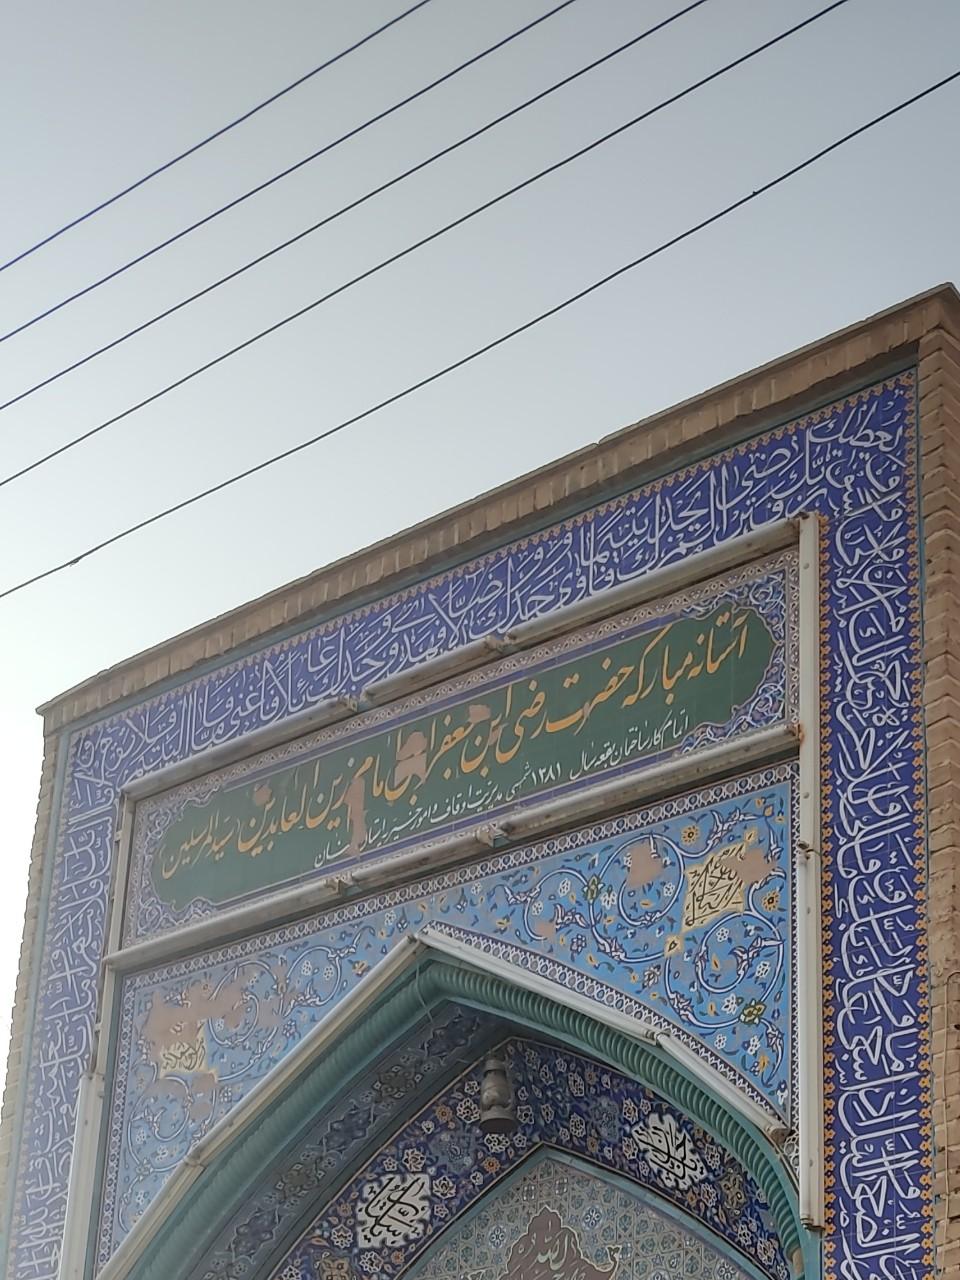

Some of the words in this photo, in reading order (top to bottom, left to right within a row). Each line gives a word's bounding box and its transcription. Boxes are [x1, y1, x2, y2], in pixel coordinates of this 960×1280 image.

[620, 623, 694, 709] مبارکه
[686, 611, 749, 680] آستانه
[496, 680, 547, 764] رضی
[545, 657, 635, 736] حضرت
